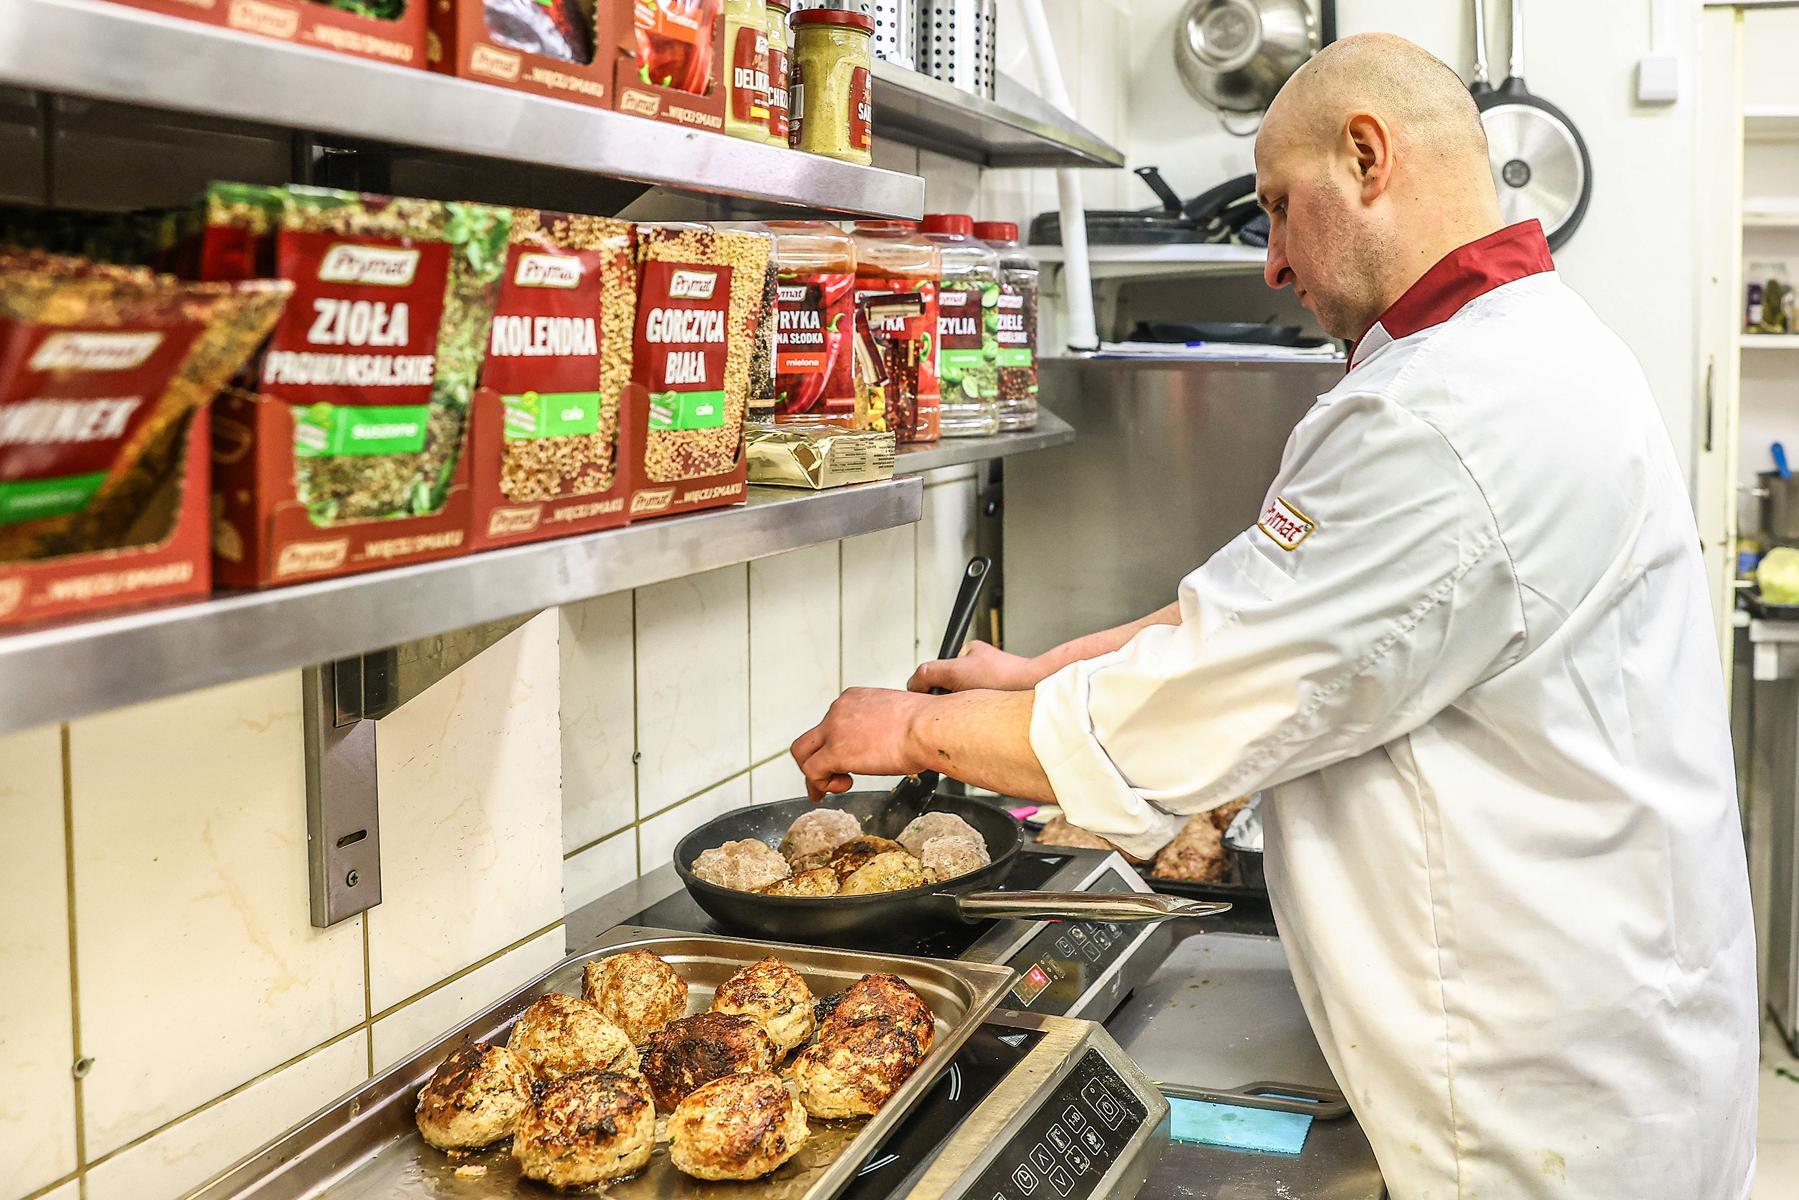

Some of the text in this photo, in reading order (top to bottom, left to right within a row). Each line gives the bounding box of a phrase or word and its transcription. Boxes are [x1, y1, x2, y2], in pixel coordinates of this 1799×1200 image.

[332, 250, 411, 280] Prymat
[524, 258, 577, 284] Prymat
[673, 274, 712, 295] Prymat
[307, 298, 409, 346] ZIOŁA
[646, 308, 725, 344] GORCZYCA
[778, 310, 821, 329] RYKA
[997, 314, 1024, 331] ZIELE
[491, 315, 598, 357] KOLENDRA
[789, 332, 824, 344] SŁODKA
[264, 351, 436, 386] PROWANSALSKIE
[664, 351, 706, 384] BIAŁA
[785, 359, 820, 367] mielona
